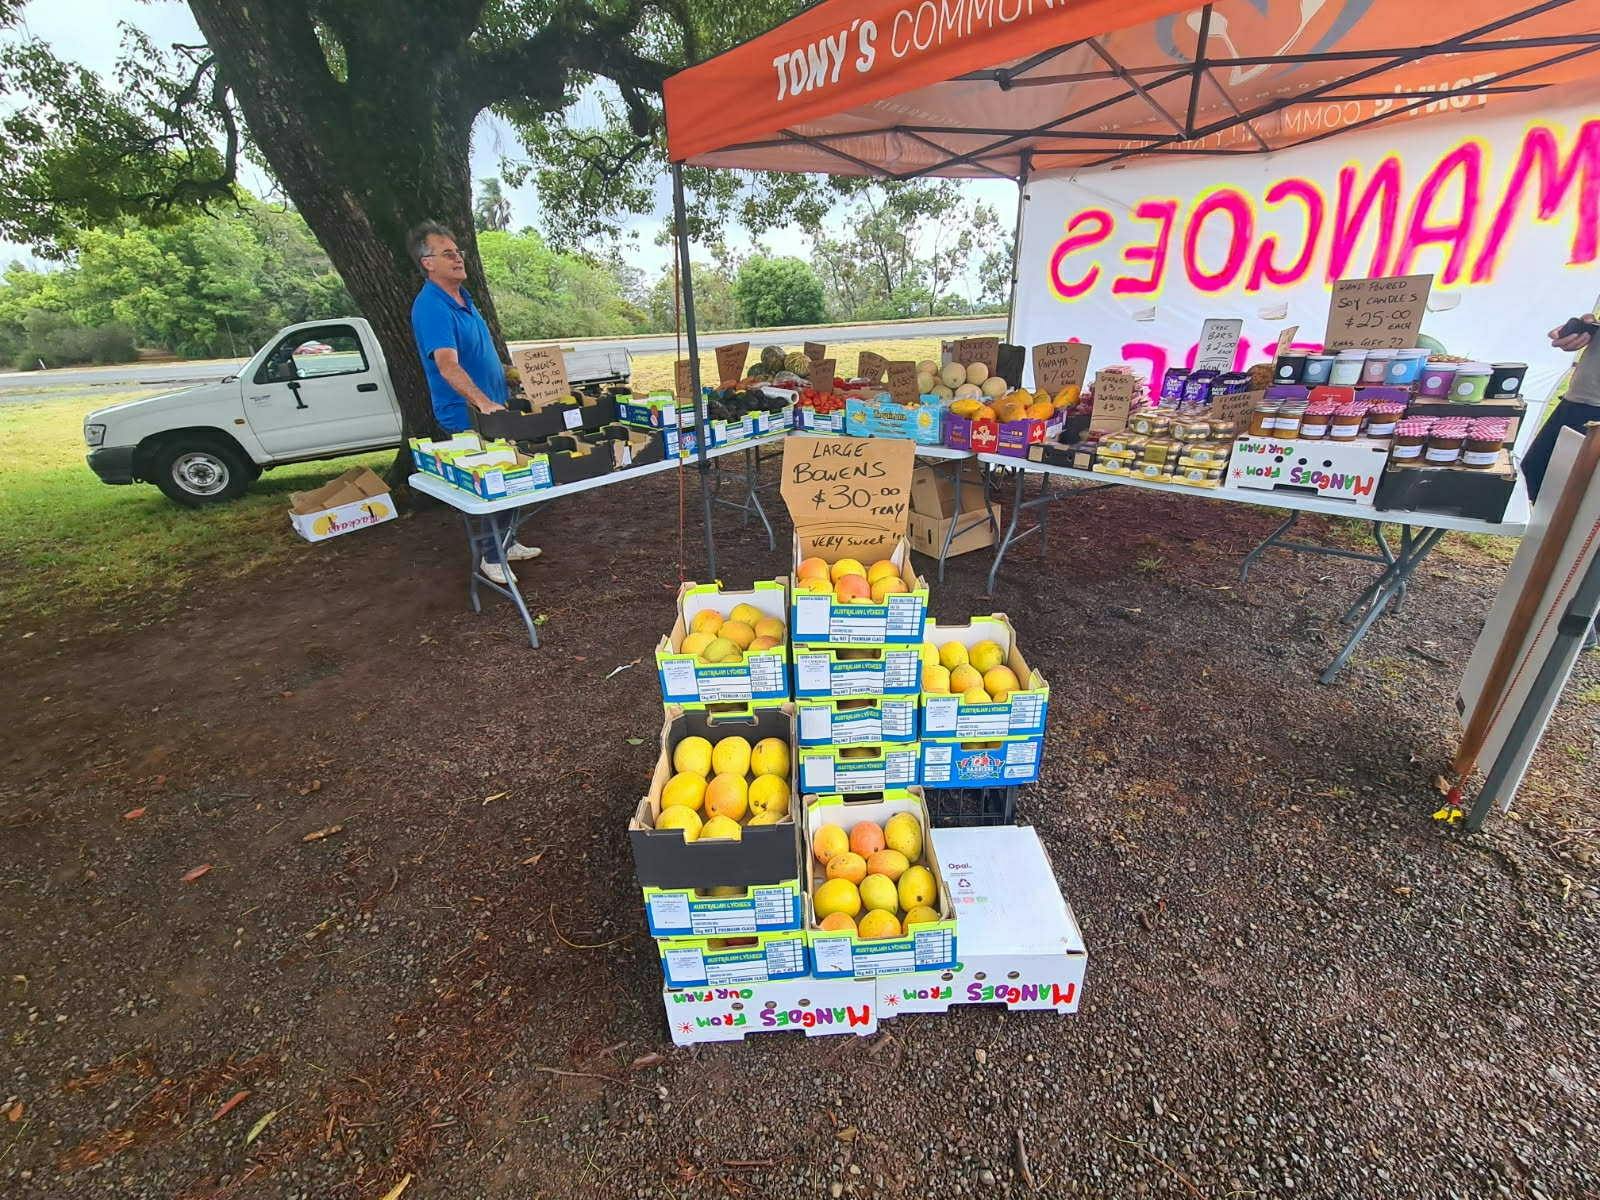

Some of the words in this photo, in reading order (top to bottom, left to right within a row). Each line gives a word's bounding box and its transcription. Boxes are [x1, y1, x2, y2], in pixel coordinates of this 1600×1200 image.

[772, 18, 877, 101] TONY'S
[812, 441, 870, 459] LARGE
[793, 461, 886, 484] BOWENS
[1246, 466, 1281, 479] FROM
[1290, 466, 1375, 496] MANGOES
[871, 503, 905, 522] TRAY
[812, 536, 843, 552] VERY
[903, 986, 953, 999] FROM
[967, 983, 1075, 1005] MANGOES
[696, 1013, 747, 1027] FROM
[760, 1005, 870, 1028] MANGOES
